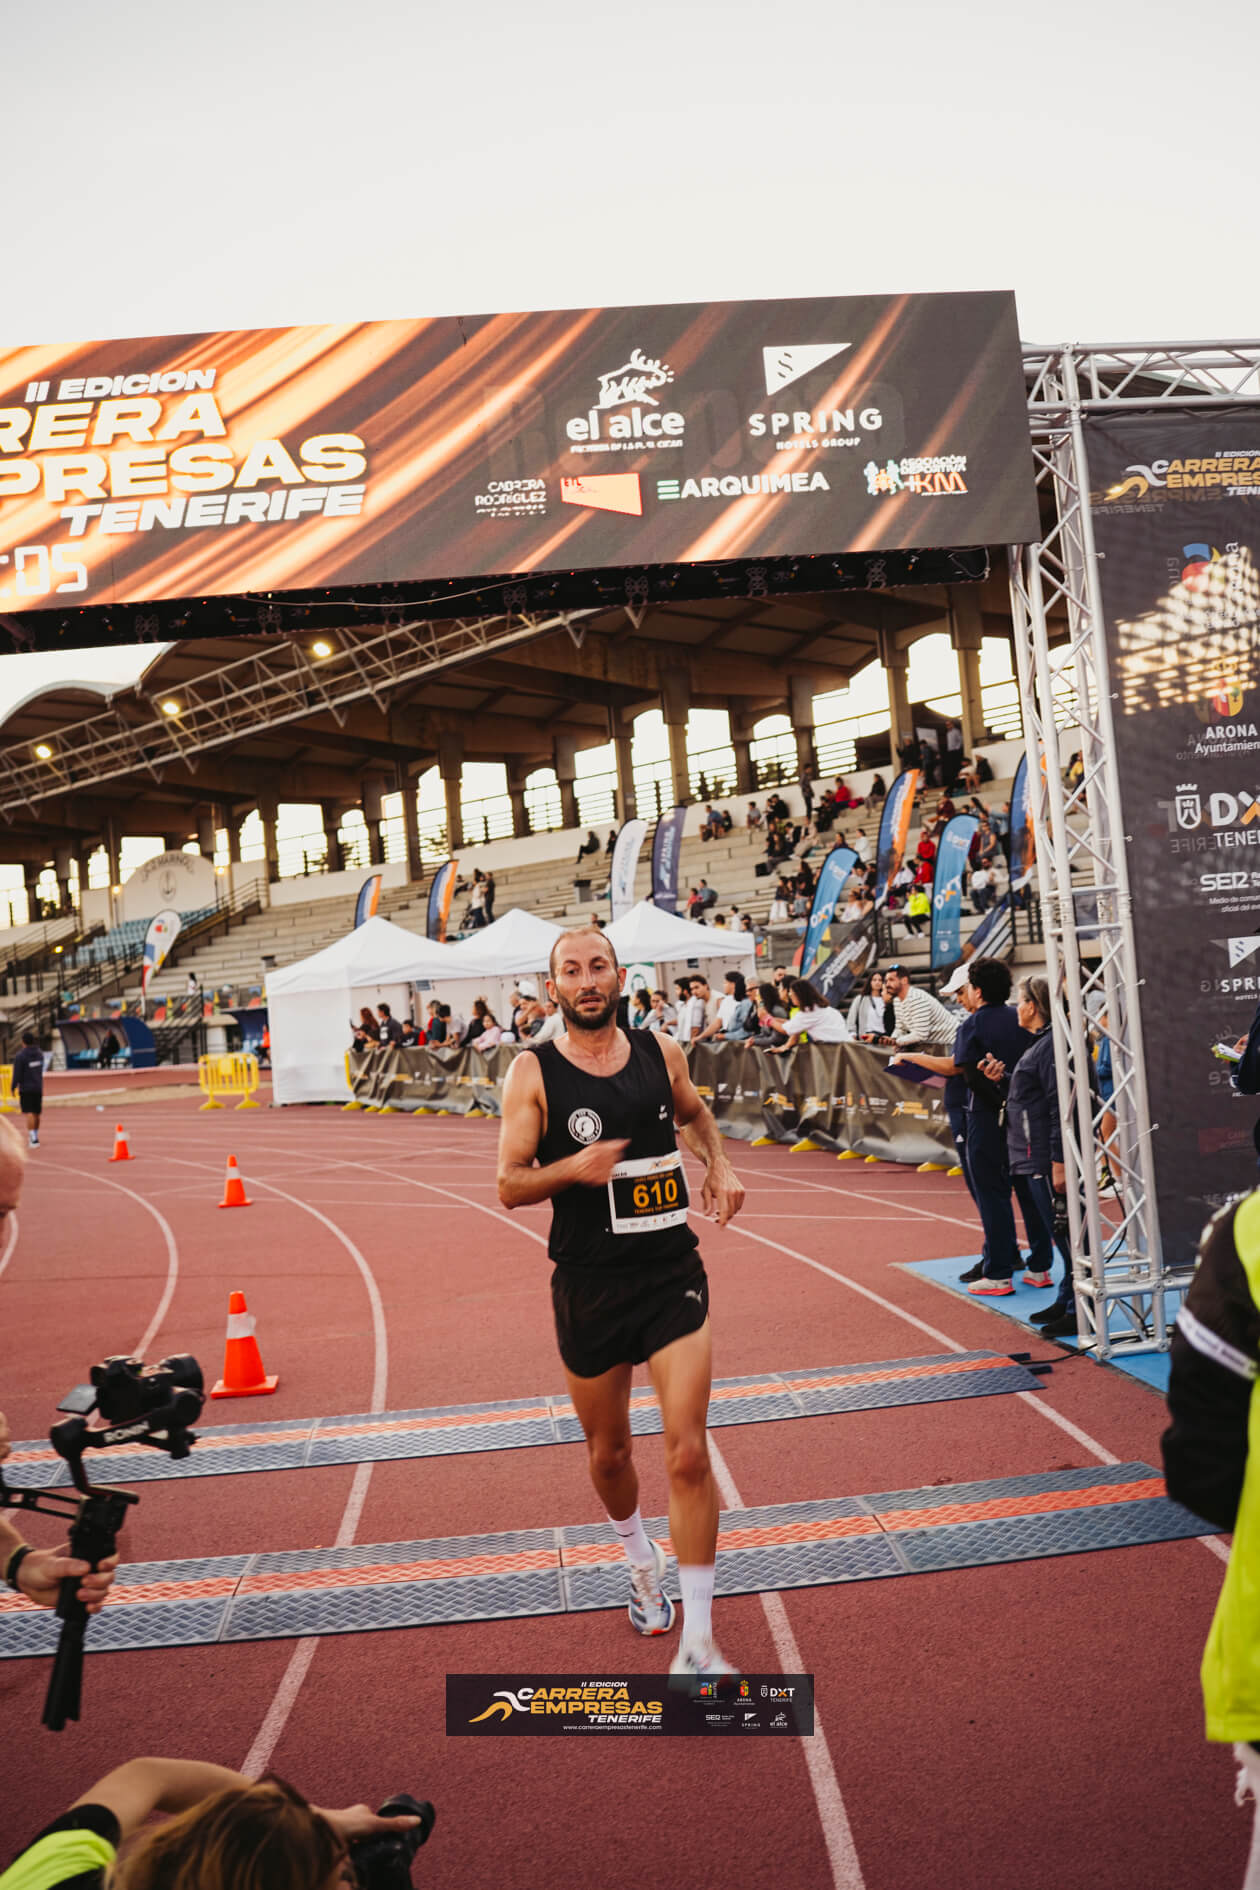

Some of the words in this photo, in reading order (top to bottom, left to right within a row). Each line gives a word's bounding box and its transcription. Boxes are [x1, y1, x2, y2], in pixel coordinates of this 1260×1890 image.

[25, 381, 50, 403] II
[57, 369, 217, 400] EDICION
[566, 409, 600, 441] el
[608, 407, 685, 439] alce
[749, 408, 882, 436] SPRING
[776, 439, 818, 450] HOTELS
[821, 437, 861, 448] GROUP
[680, 471, 831, 499] ARQUIMEA
[60, 484, 366, 536] TENERIFE
[1205, 723, 1258, 740] ARONA
[1200, 871, 1249, 891] SER
[633, 1178, 678, 1208] 610
